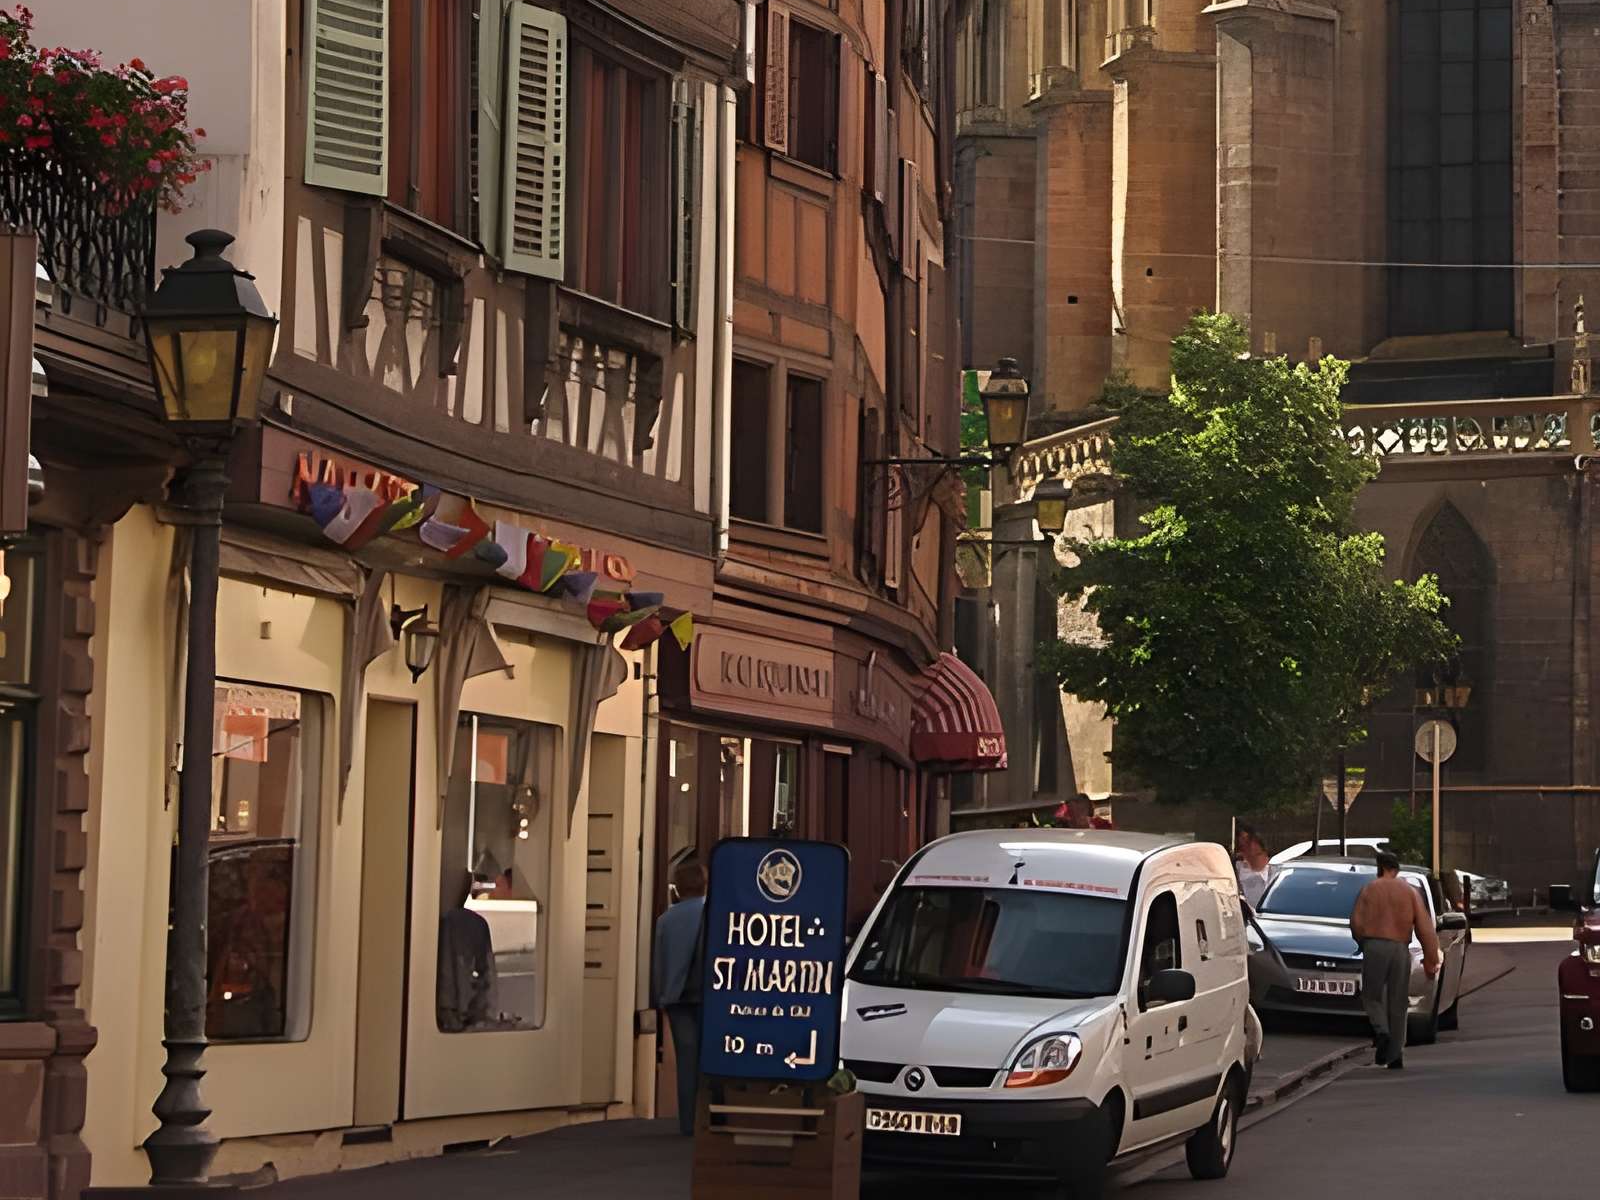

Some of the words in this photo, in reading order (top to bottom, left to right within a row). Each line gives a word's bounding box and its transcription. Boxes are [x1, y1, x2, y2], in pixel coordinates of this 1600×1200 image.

[727, 912, 805, 948] HOTEL
[712, 957, 736, 991] ST
[744, 958, 834, 995] MARTIN
[724, 1035, 746, 1054] 10
